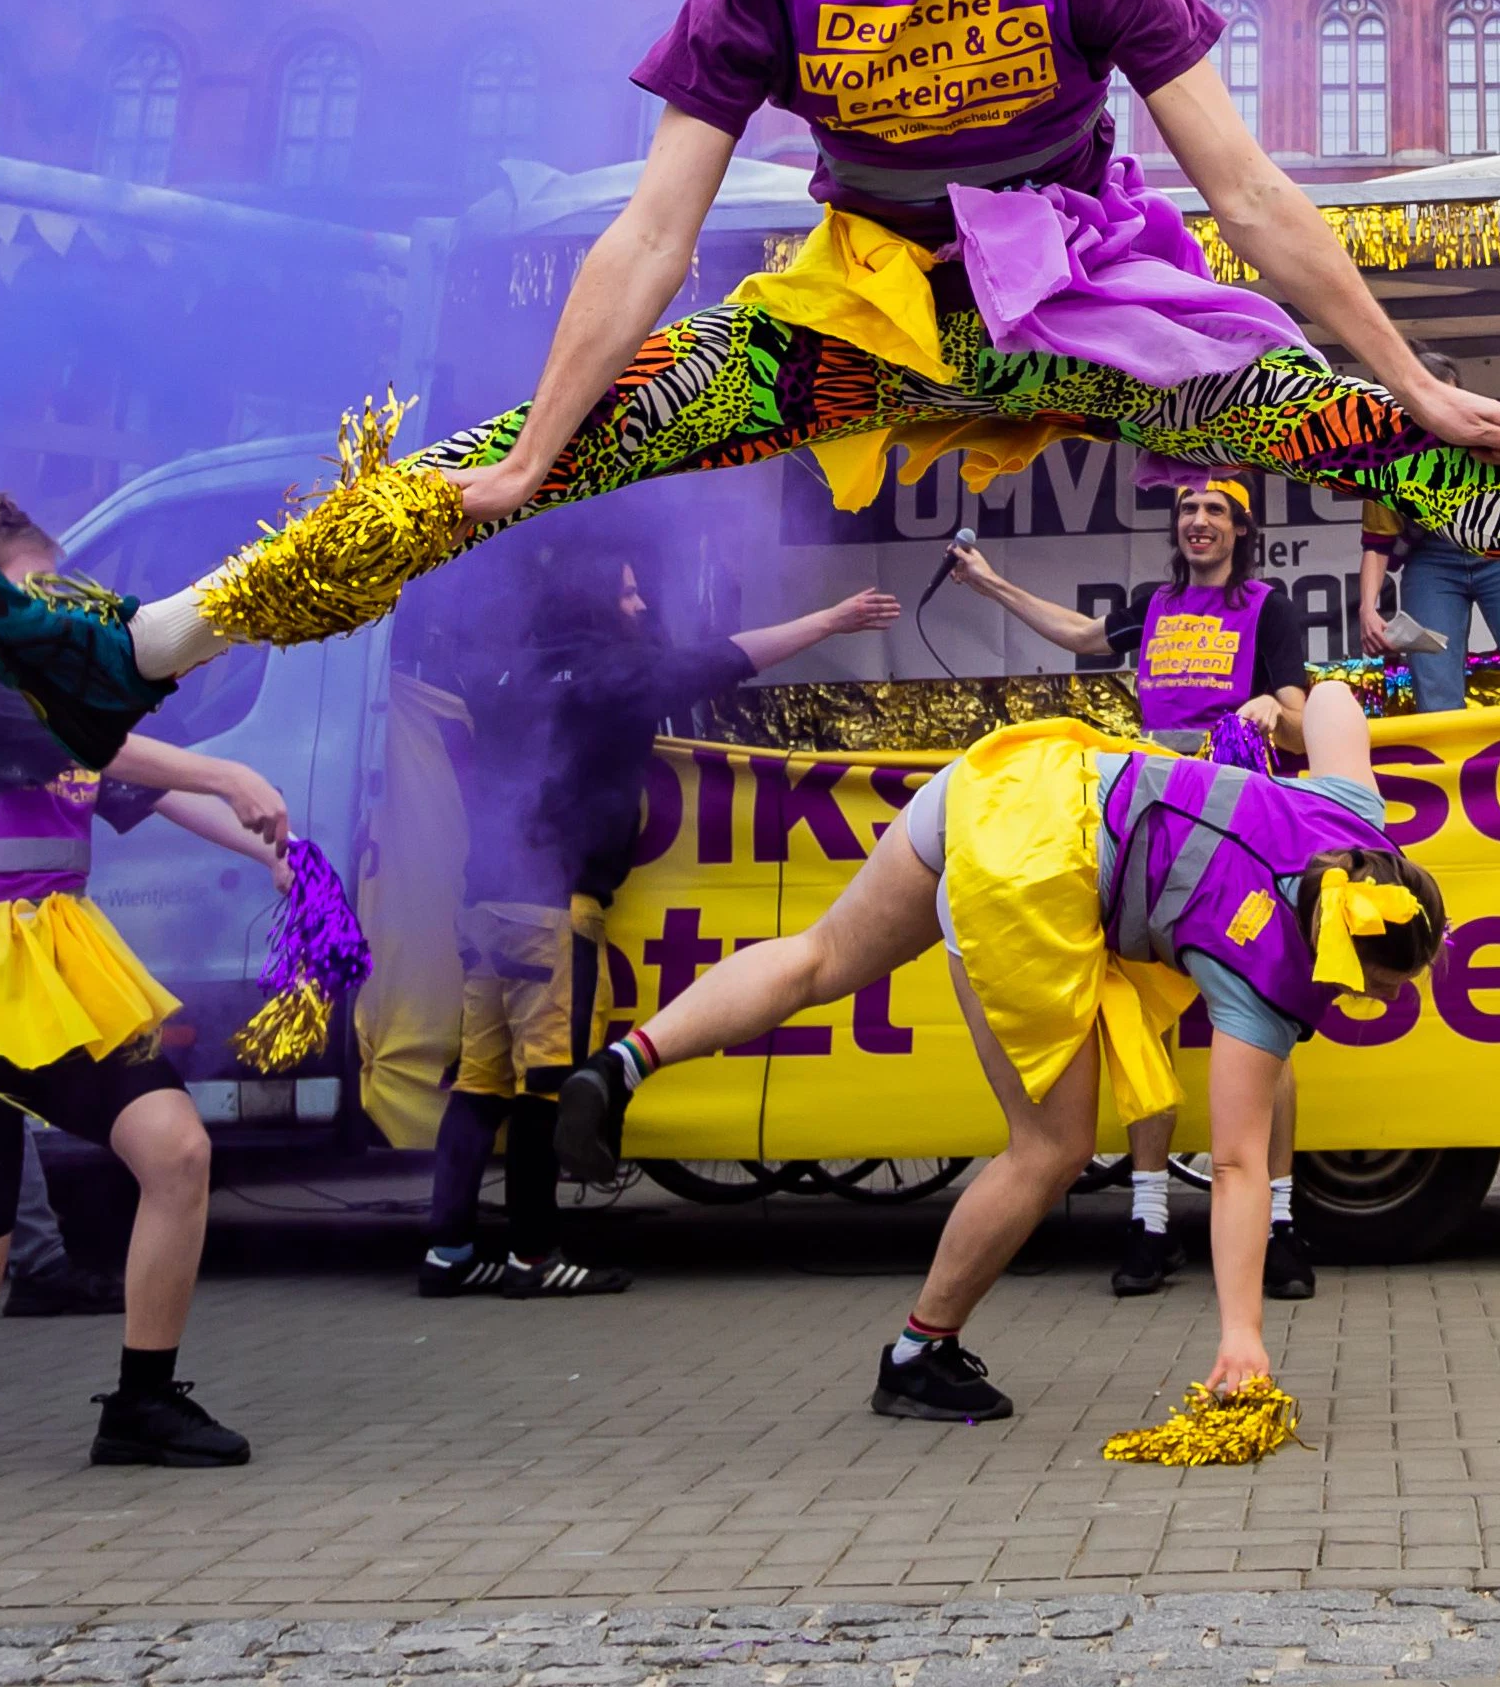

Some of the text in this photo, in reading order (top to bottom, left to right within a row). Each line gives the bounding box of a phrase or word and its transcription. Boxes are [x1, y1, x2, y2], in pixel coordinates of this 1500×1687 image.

[806, 17, 1044, 91] Wohnen & Co
[849, 52, 1049, 115] enteignen!
[1197, 635, 1208, 649] &
[1213, 635, 1236, 649] Co
